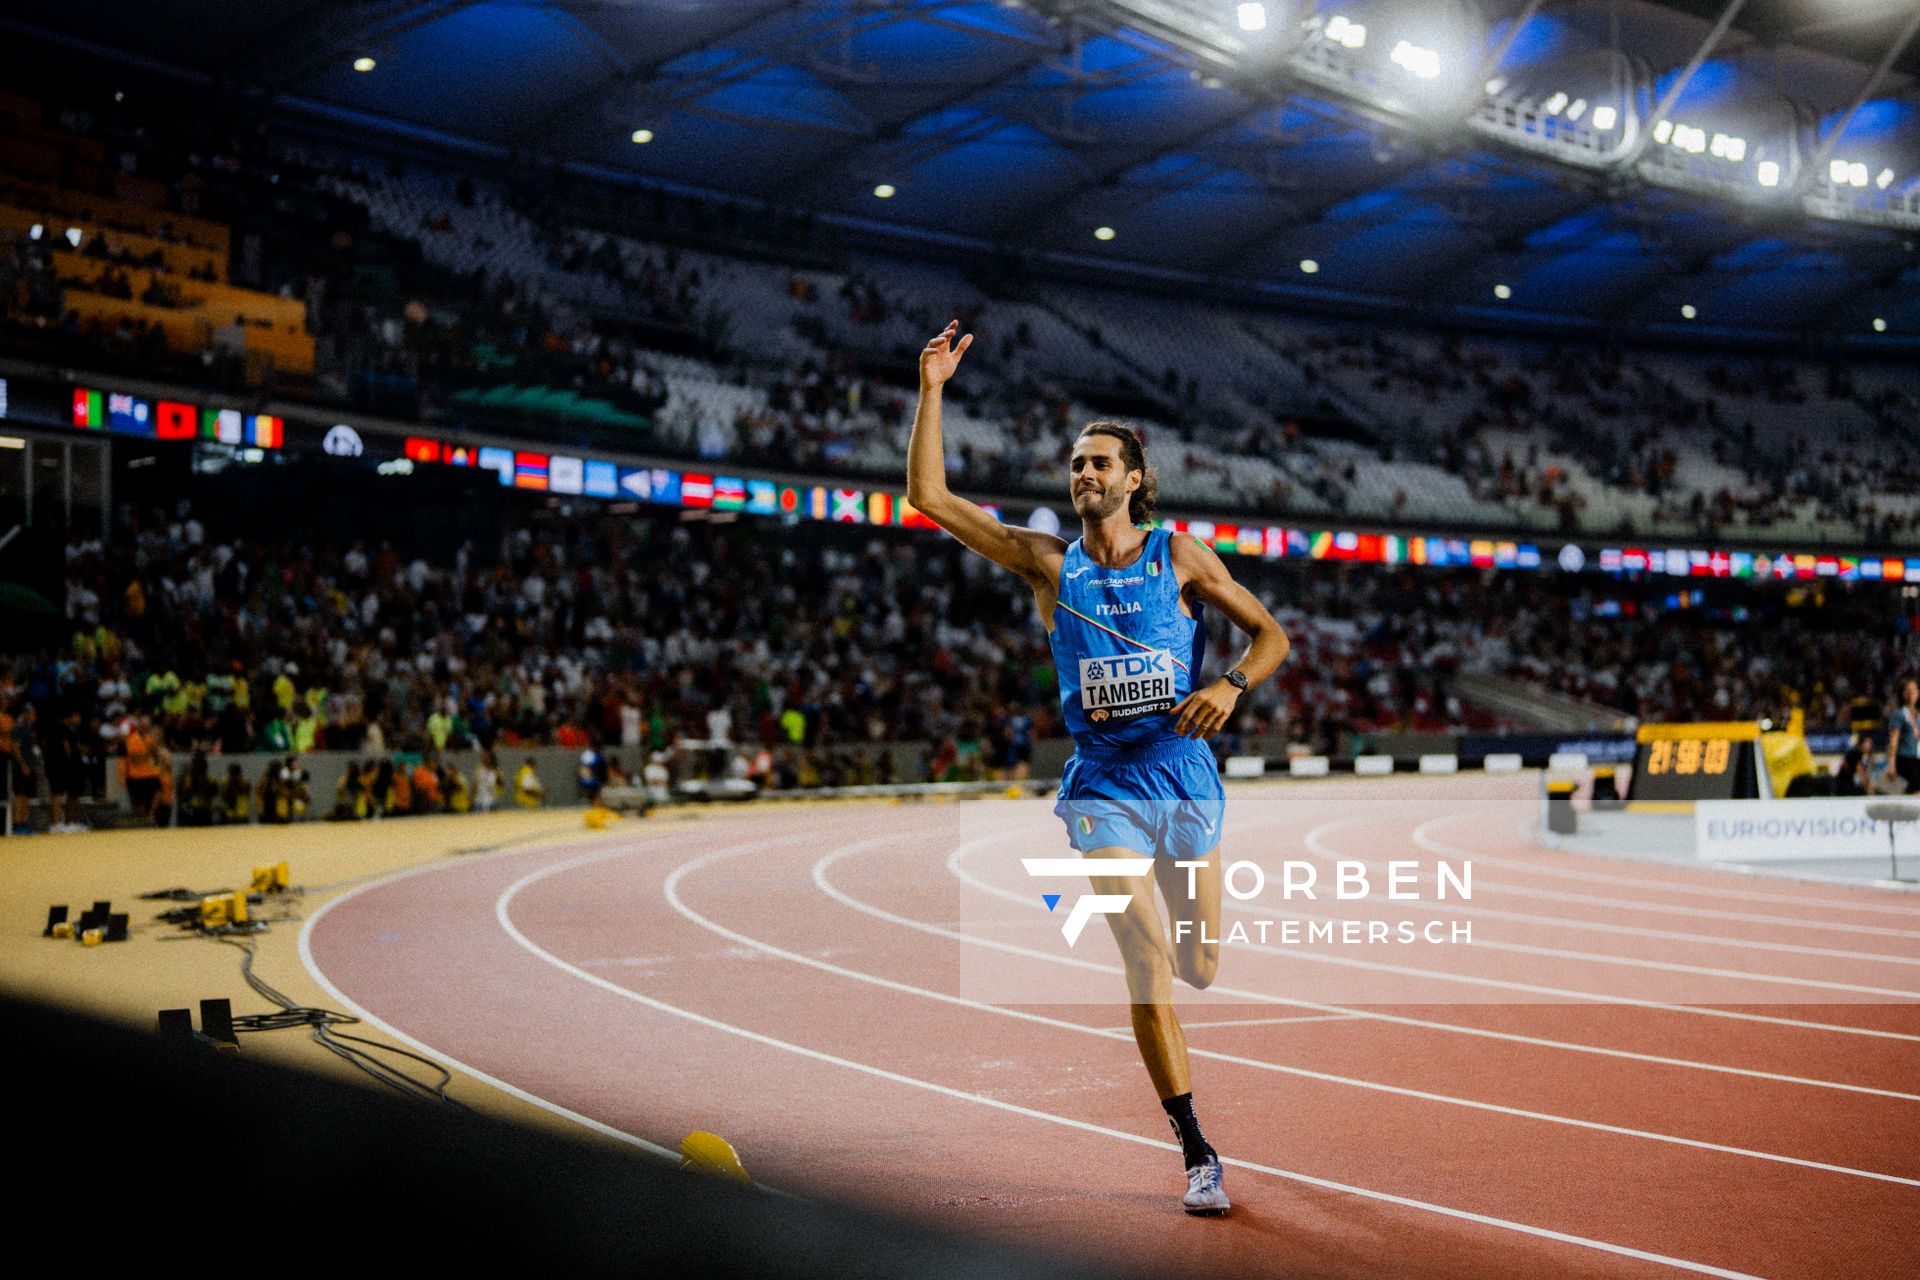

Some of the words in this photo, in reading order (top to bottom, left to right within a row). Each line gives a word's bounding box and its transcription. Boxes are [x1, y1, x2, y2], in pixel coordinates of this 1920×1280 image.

[1096, 601, 1142, 615] ITALIA
[1103, 654, 1167, 678] TDK
[1086, 677, 1169, 706] TAMBERI
[1111, 703, 1159, 717] BUDAPEST
[1160, 702, 1171, 710] 23
